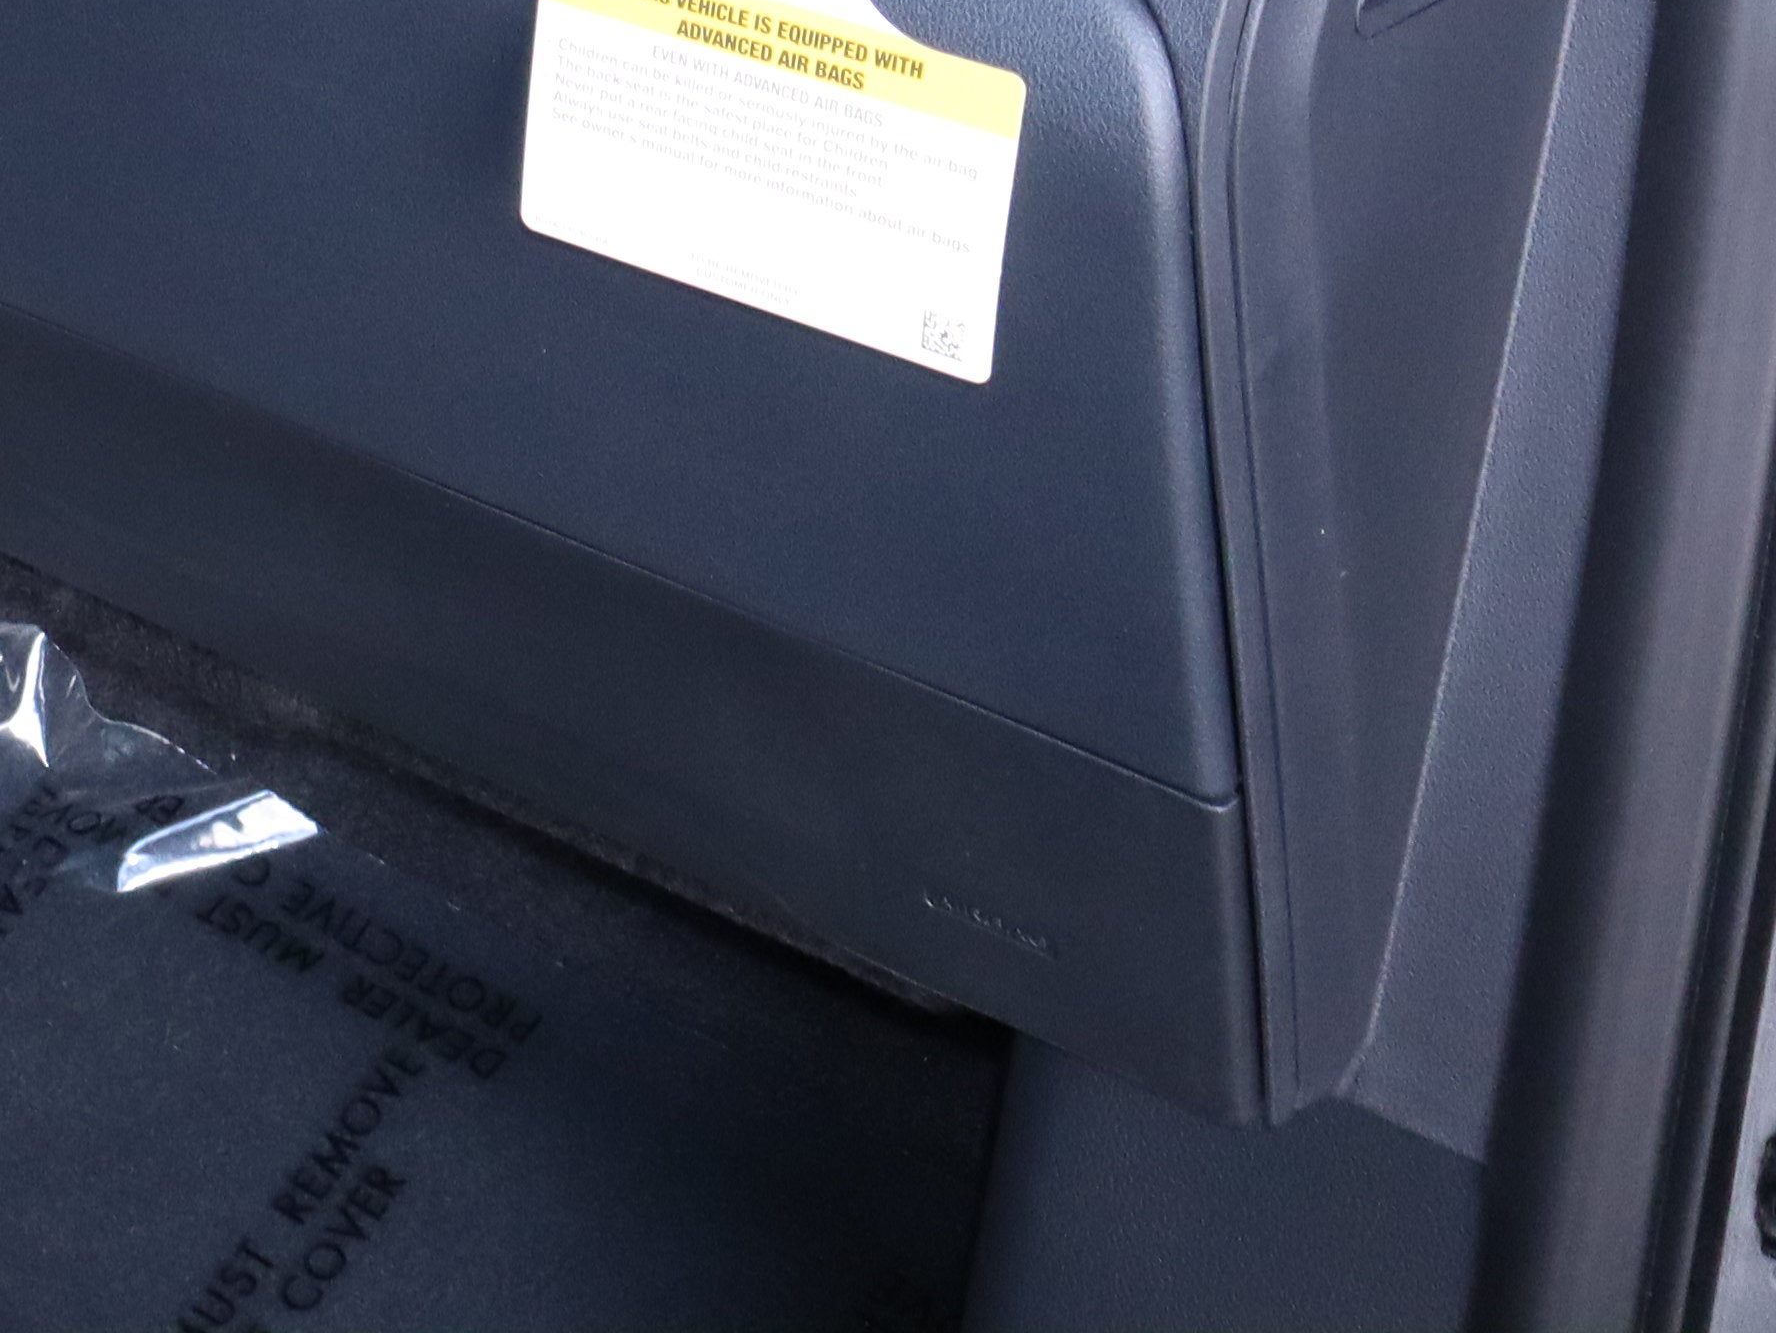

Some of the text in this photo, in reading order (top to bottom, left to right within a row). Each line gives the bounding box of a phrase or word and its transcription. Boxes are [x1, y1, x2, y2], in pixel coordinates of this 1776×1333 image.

[652, 45, 883, 127] EVEN WITH ADVANCED AIR BAGS
[676, 19, 866, 90] ADVANCED AIR BAGS
[754, 11, 771, 34] IS
[777, 20, 868, 63] EQUIPPED
[875, 48, 924, 79] WITH
[557, 55, 582, 72] The
[587, 64, 620, 84] back
[625, 79, 655, 97] seat
[676, 93, 699, 108] the
[704, 103, 749, 126] safest
[752, 117, 792, 139] place
[797, 130, 817, 147] for
[823, 139, 889, 171] Children
[558, 37, 618, 67] Children
[623, 61, 648, 75] can
[652, 67, 670, 82] be
[675, 74, 714, 96] killed
[738, 95, 808, 128] seriously
[811, 116, 865, 143] injured
[870, 135, 889, 153] by
[894, 143, 919, 161] the
[923, 153, 943, 167] air
[948, 160, 978, 181] bag
[763, 139, 793, 159] seat
[798, 148, 812, 164] in
[817, 154, 841, 173] the
[846, 165, 883, 187] front
[581, 118, 637, 144] owners
[641, 138, 695, 165] manual
[699, 155, 718, 169] for
[723, 164, 761, 185] more
[766, 178, 854, 215] information
[858, 209, 902, 232] about
[906, 224, 926, 238] air
[931, 231, 970, 254] bags
[196, 894, 324, 973] MUST
[279, 879, 543, 1042] PROTECTIVE
[343, 978, 507, 1079] DEALER
[270, 1045, 428, 1227] REMOVE
[279, 1165, 408, 1313] COVER
